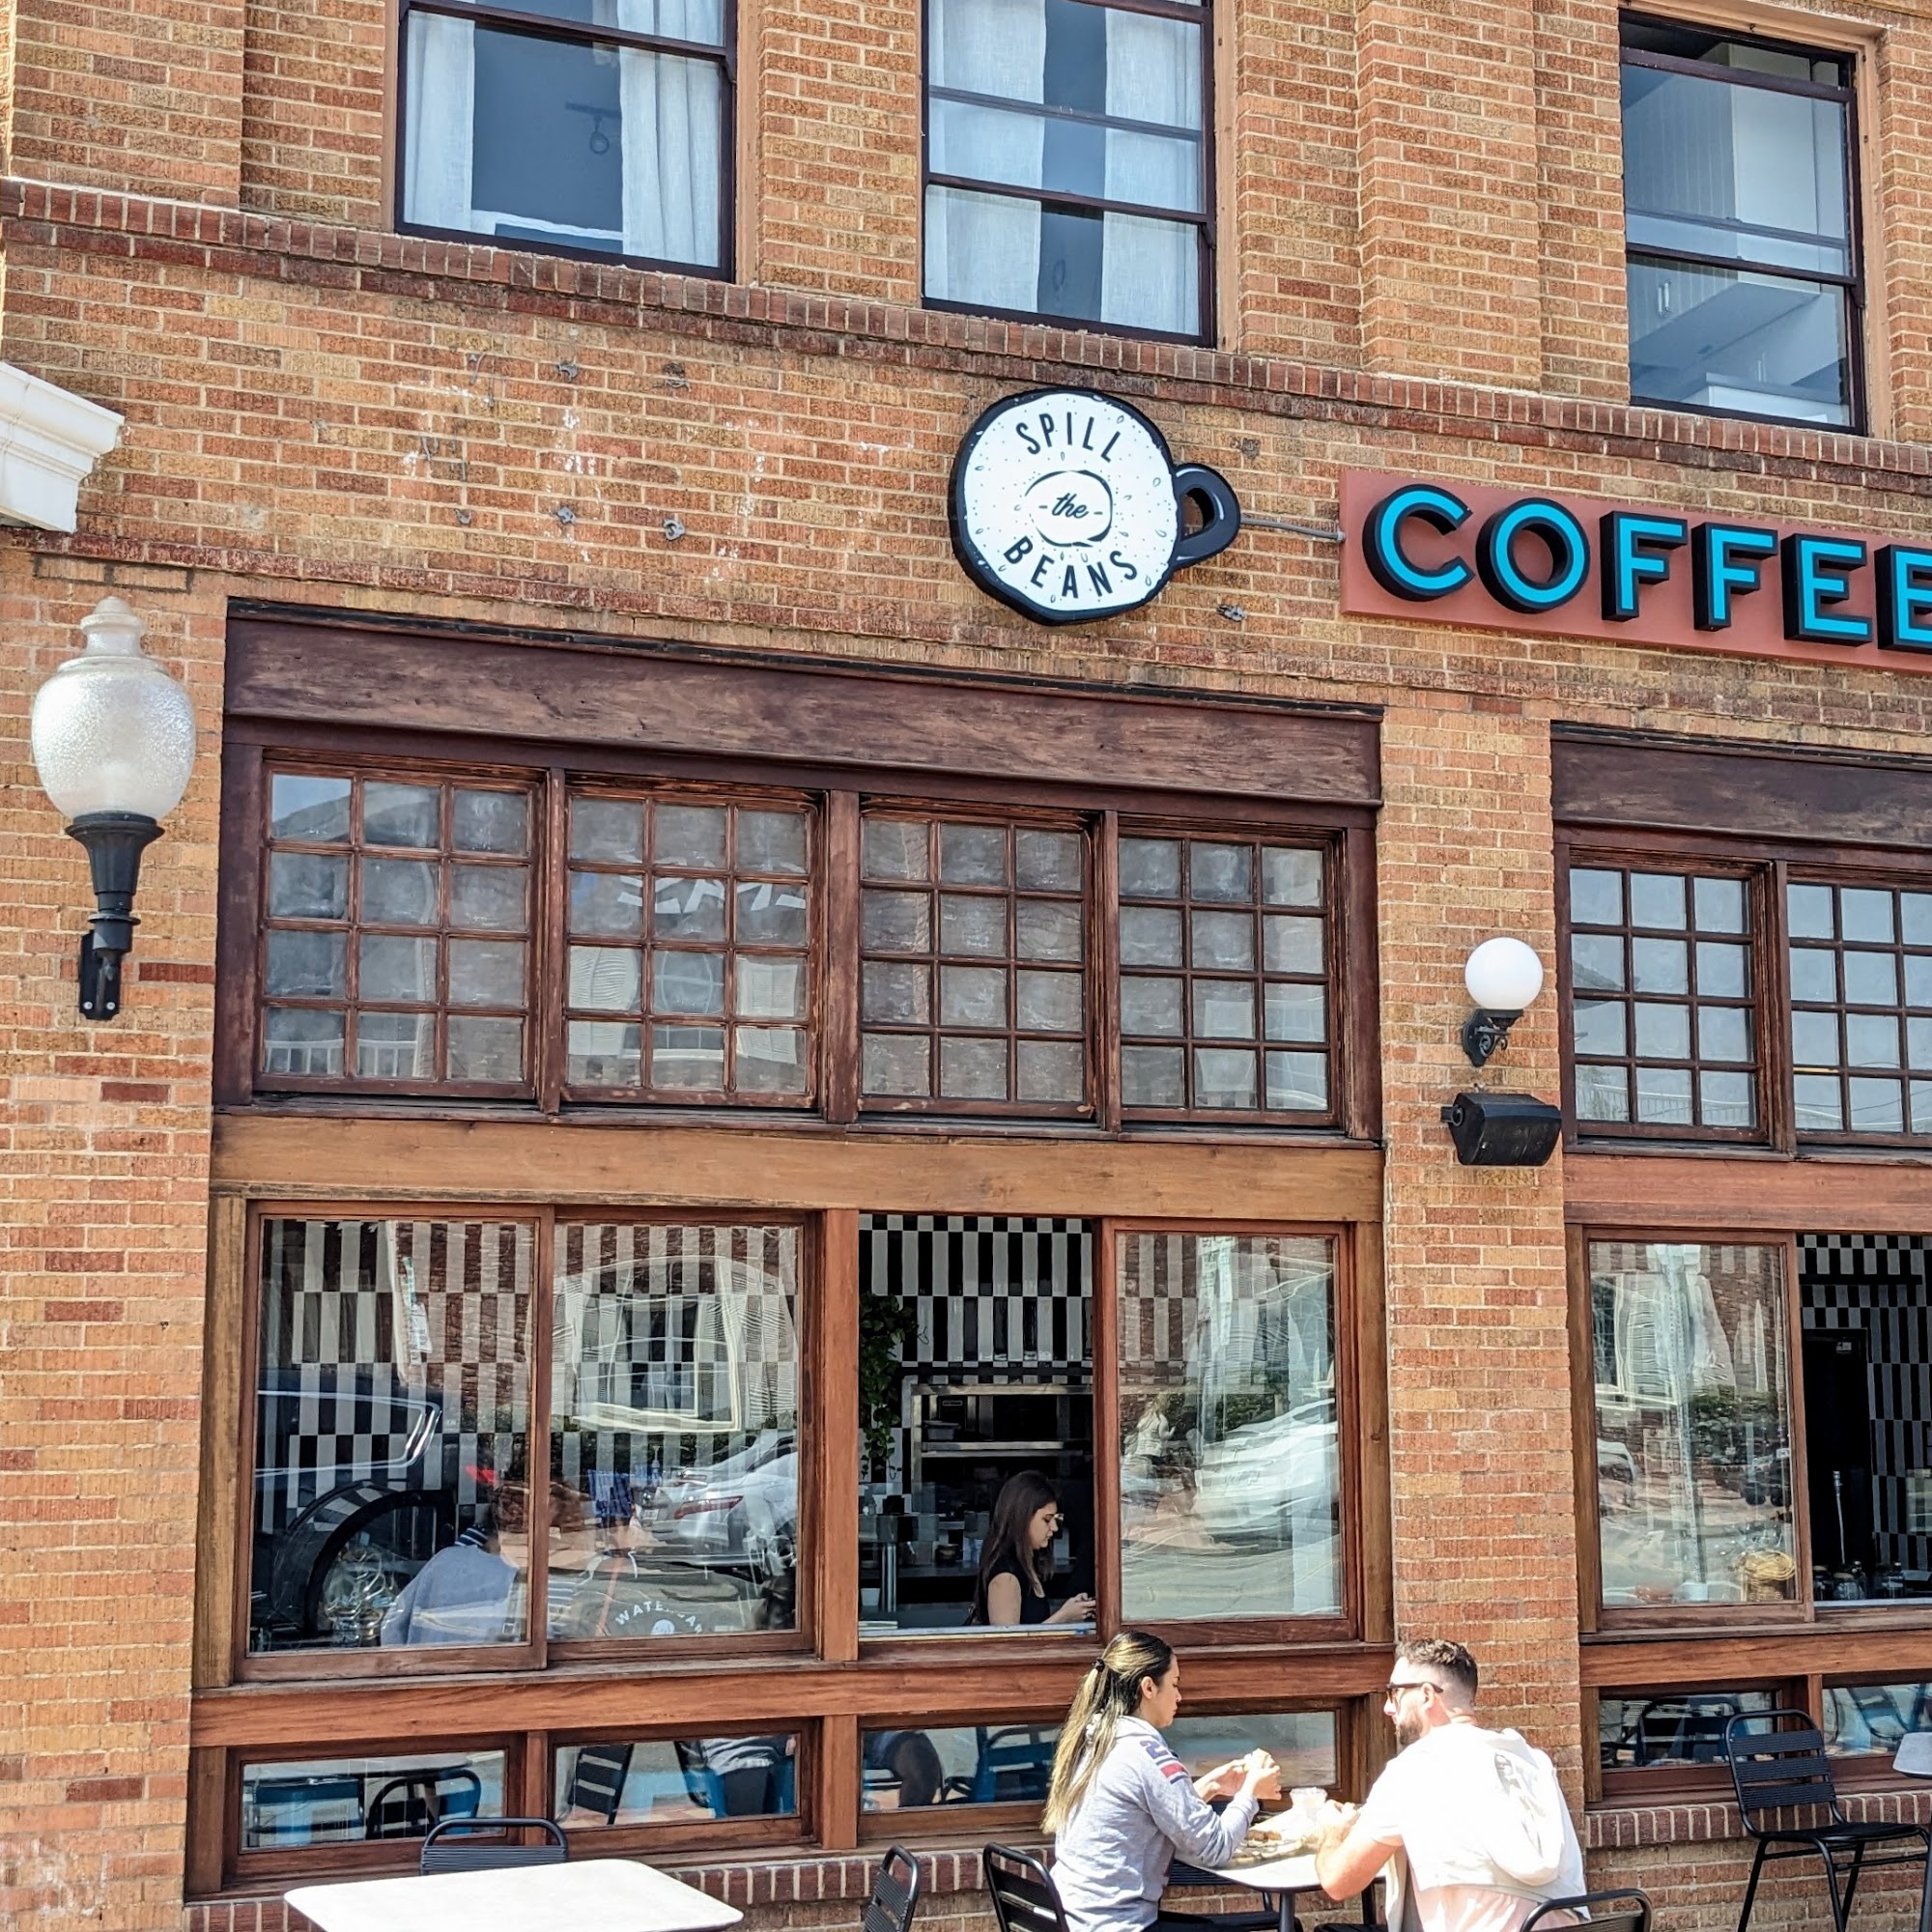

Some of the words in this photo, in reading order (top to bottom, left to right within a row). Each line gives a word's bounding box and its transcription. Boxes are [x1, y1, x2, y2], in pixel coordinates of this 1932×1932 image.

[1016, 412, 1121, 463] SPILL
[1051, 493, 1089, 519] the
[1004, 535, 1137, 599] BEANS
[1362, 484, 1932, 652] COFFEE
